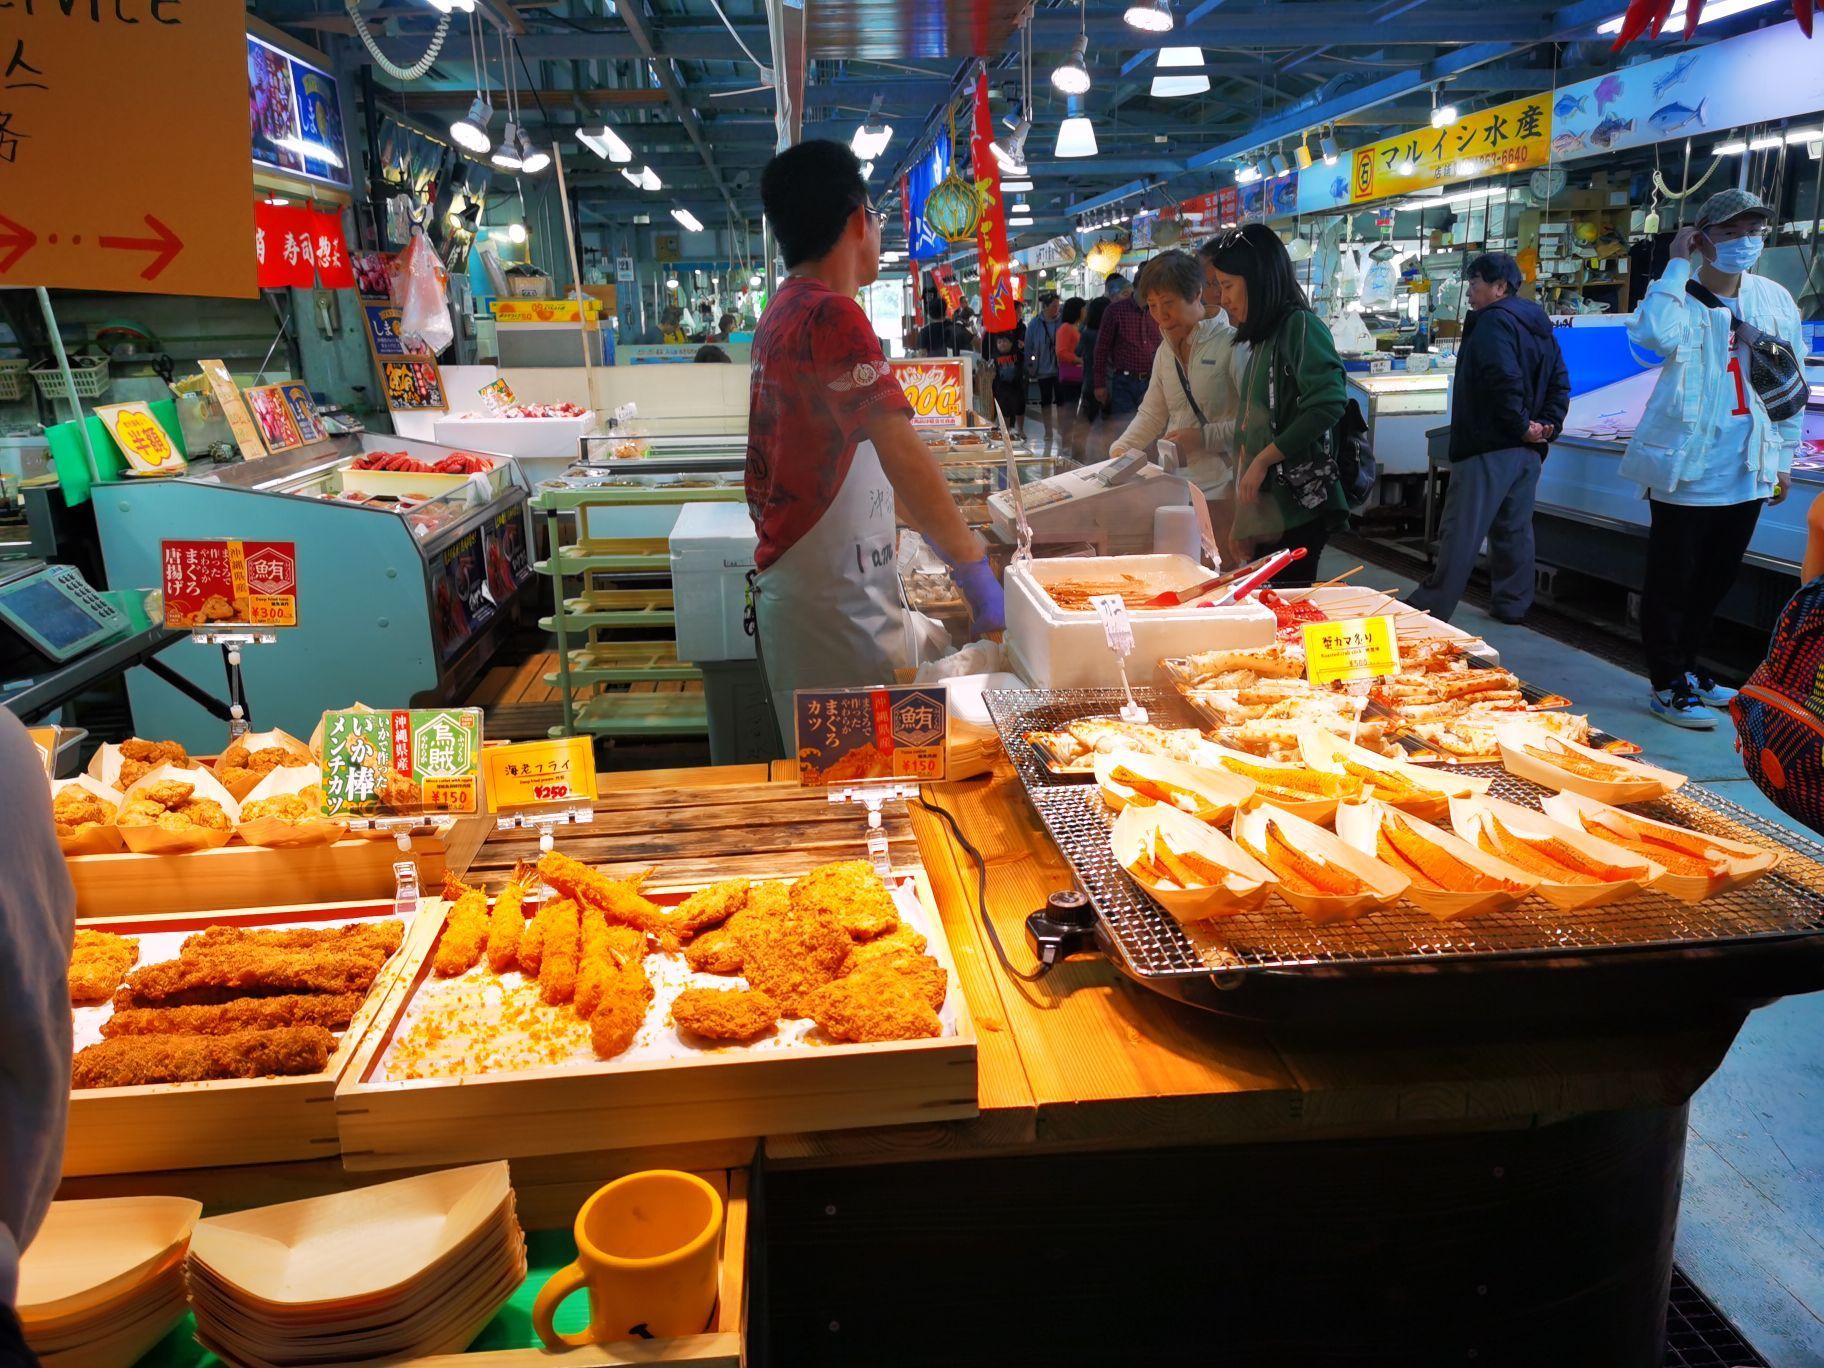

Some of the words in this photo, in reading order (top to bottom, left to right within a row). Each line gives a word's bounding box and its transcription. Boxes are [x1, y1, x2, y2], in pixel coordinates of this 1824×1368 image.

[1380, 104, 1544, 169] マルイシ水産
[283, 231, 315, 267] 寿司
[1726, 356, 1752, 416] 1
[165, 548, 184, 596] 唐揚げ
[185, 548, 201, 596] まぐろ
[254, 559, 285, 580] 鮪
[252, 607, 284, 618] ¥300
[807, 700, 822, 731] カツ
[825, 699, 840, 748] まぐろ
[899, 705, 934, 730] 鮪
[345, 716, 375, 801] いか棒
[375, 717, 391, 789] いかで作った
[395, 714, 408, 772] 沖縄県産
[326, 716, 347, 816] メンチカツ
[504, 759, 570, 777] 海老フライ
[903, 760, 936, 772] ¥150
[432, 790, 467, 804] ¥150
[534, 785, 568, 800] ¥250
